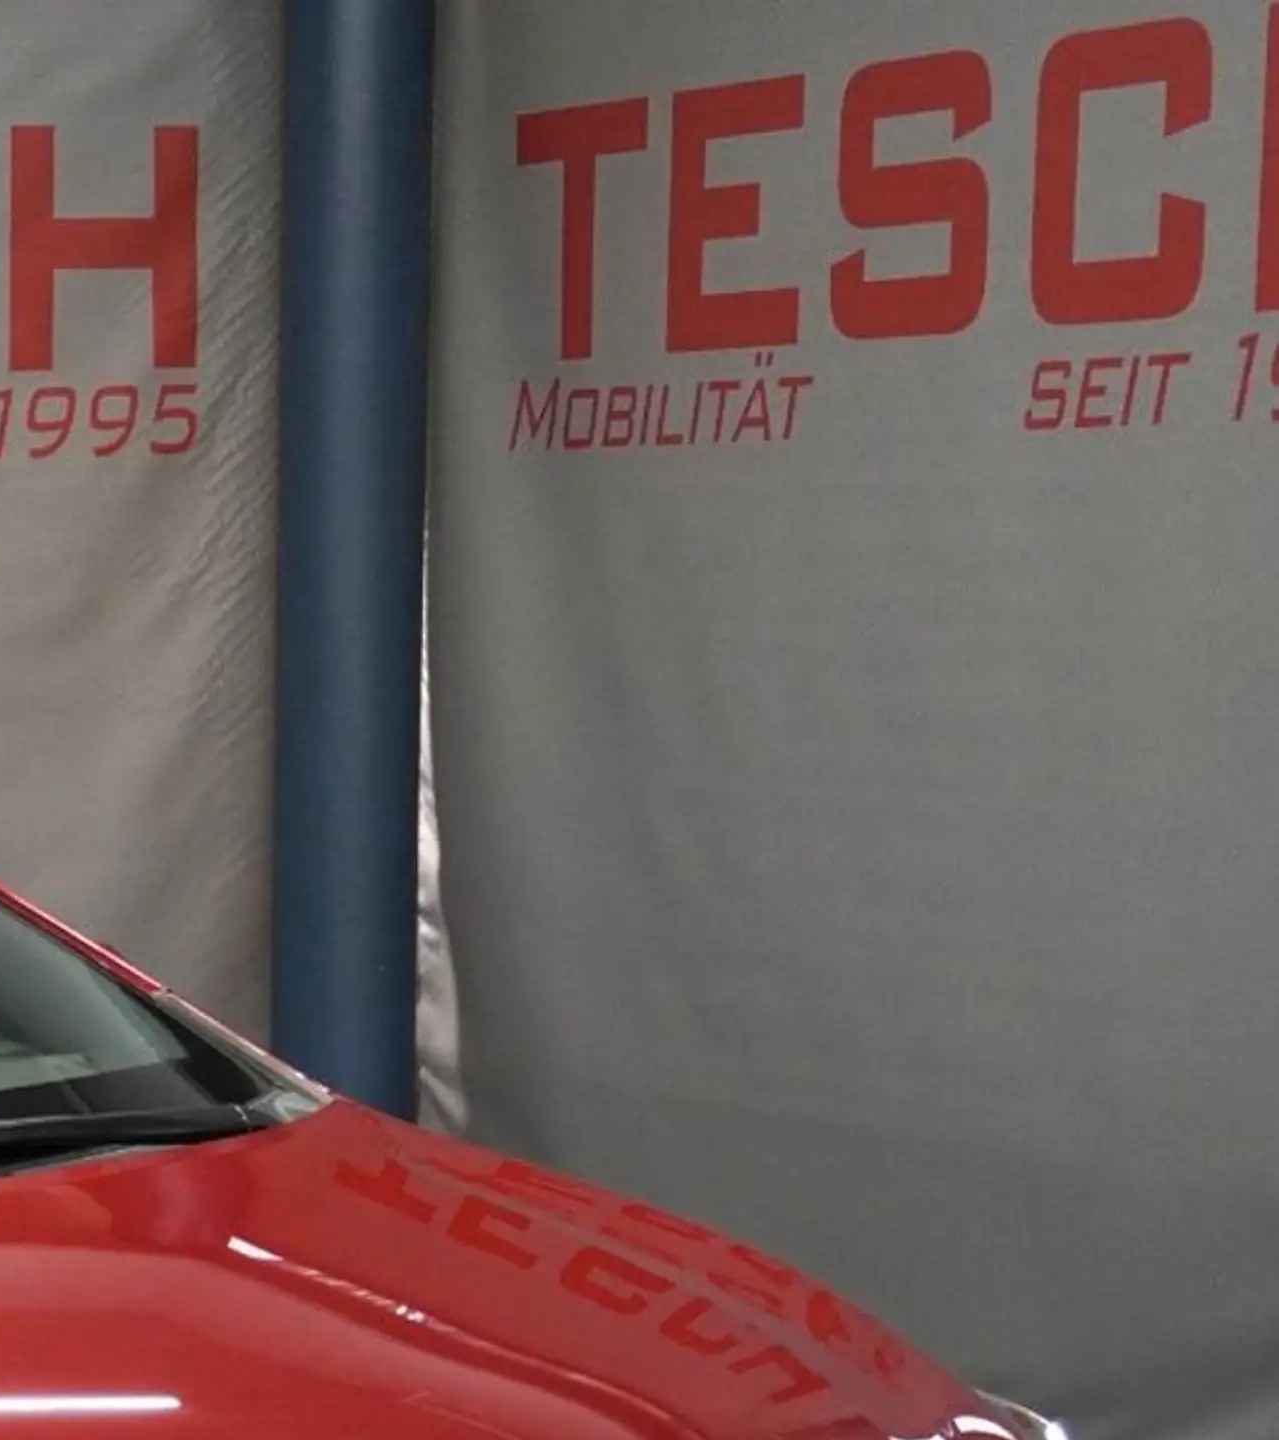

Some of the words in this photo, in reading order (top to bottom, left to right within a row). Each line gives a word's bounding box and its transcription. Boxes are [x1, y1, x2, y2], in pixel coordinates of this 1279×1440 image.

[516, 0, 1279, 361] TESC
[509, 352, 813, 452] MOBILITÄT
[1022, 352, 1191, 432] SEIT
